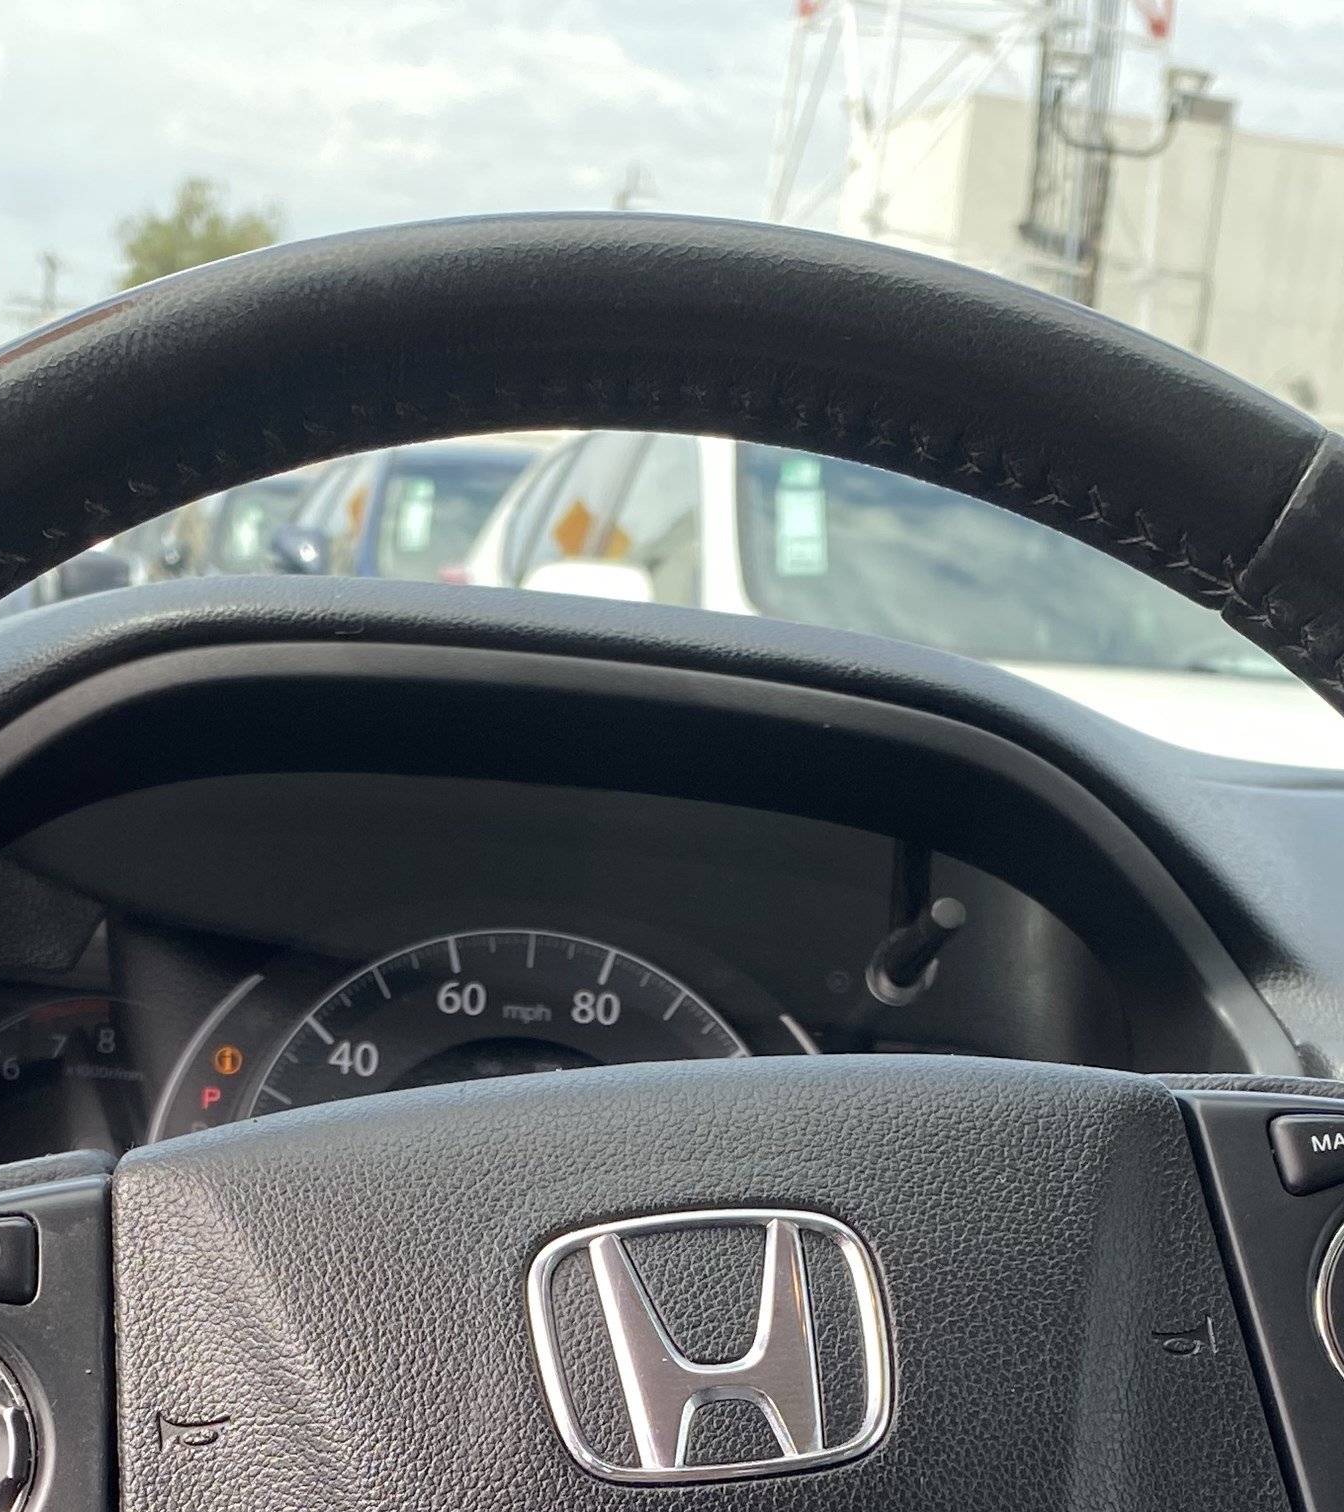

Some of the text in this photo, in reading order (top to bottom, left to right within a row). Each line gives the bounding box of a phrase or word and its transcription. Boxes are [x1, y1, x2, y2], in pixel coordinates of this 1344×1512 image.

[437, 981, 488, 1018] 60
[503, 1003, 552, 1024] mph
[571, 990, 621, 1027] 80
[2, 1057, 21, 1081] 6
[328, 1041, 380, 1078] 40
[201, 1086, 221, 1110] P
